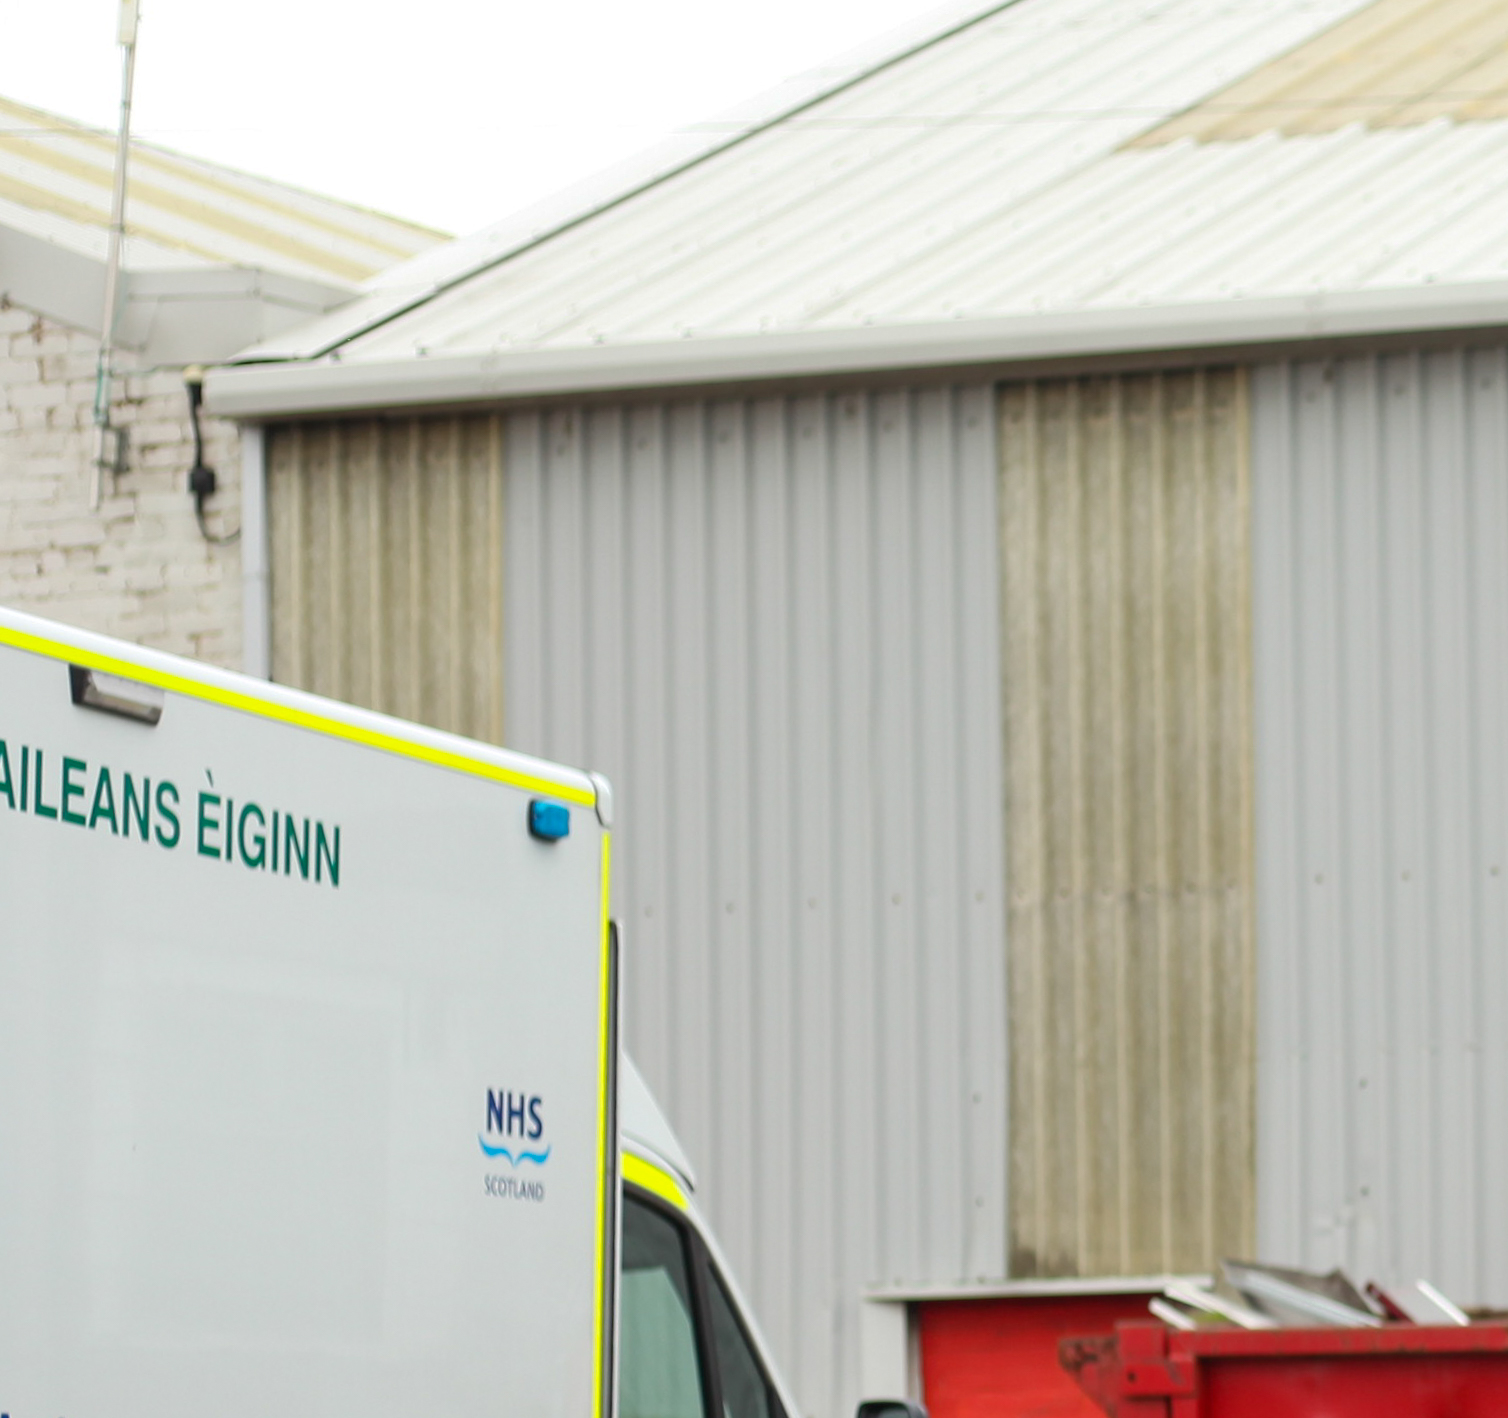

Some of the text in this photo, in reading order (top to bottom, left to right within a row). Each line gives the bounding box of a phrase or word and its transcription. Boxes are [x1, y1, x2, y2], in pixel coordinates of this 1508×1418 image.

[197, 768, 341, 888] ÈIGINN
[486, 1087, 543, 1140] NHS
[484, 1174, 545, 1202] SCOTLAND
